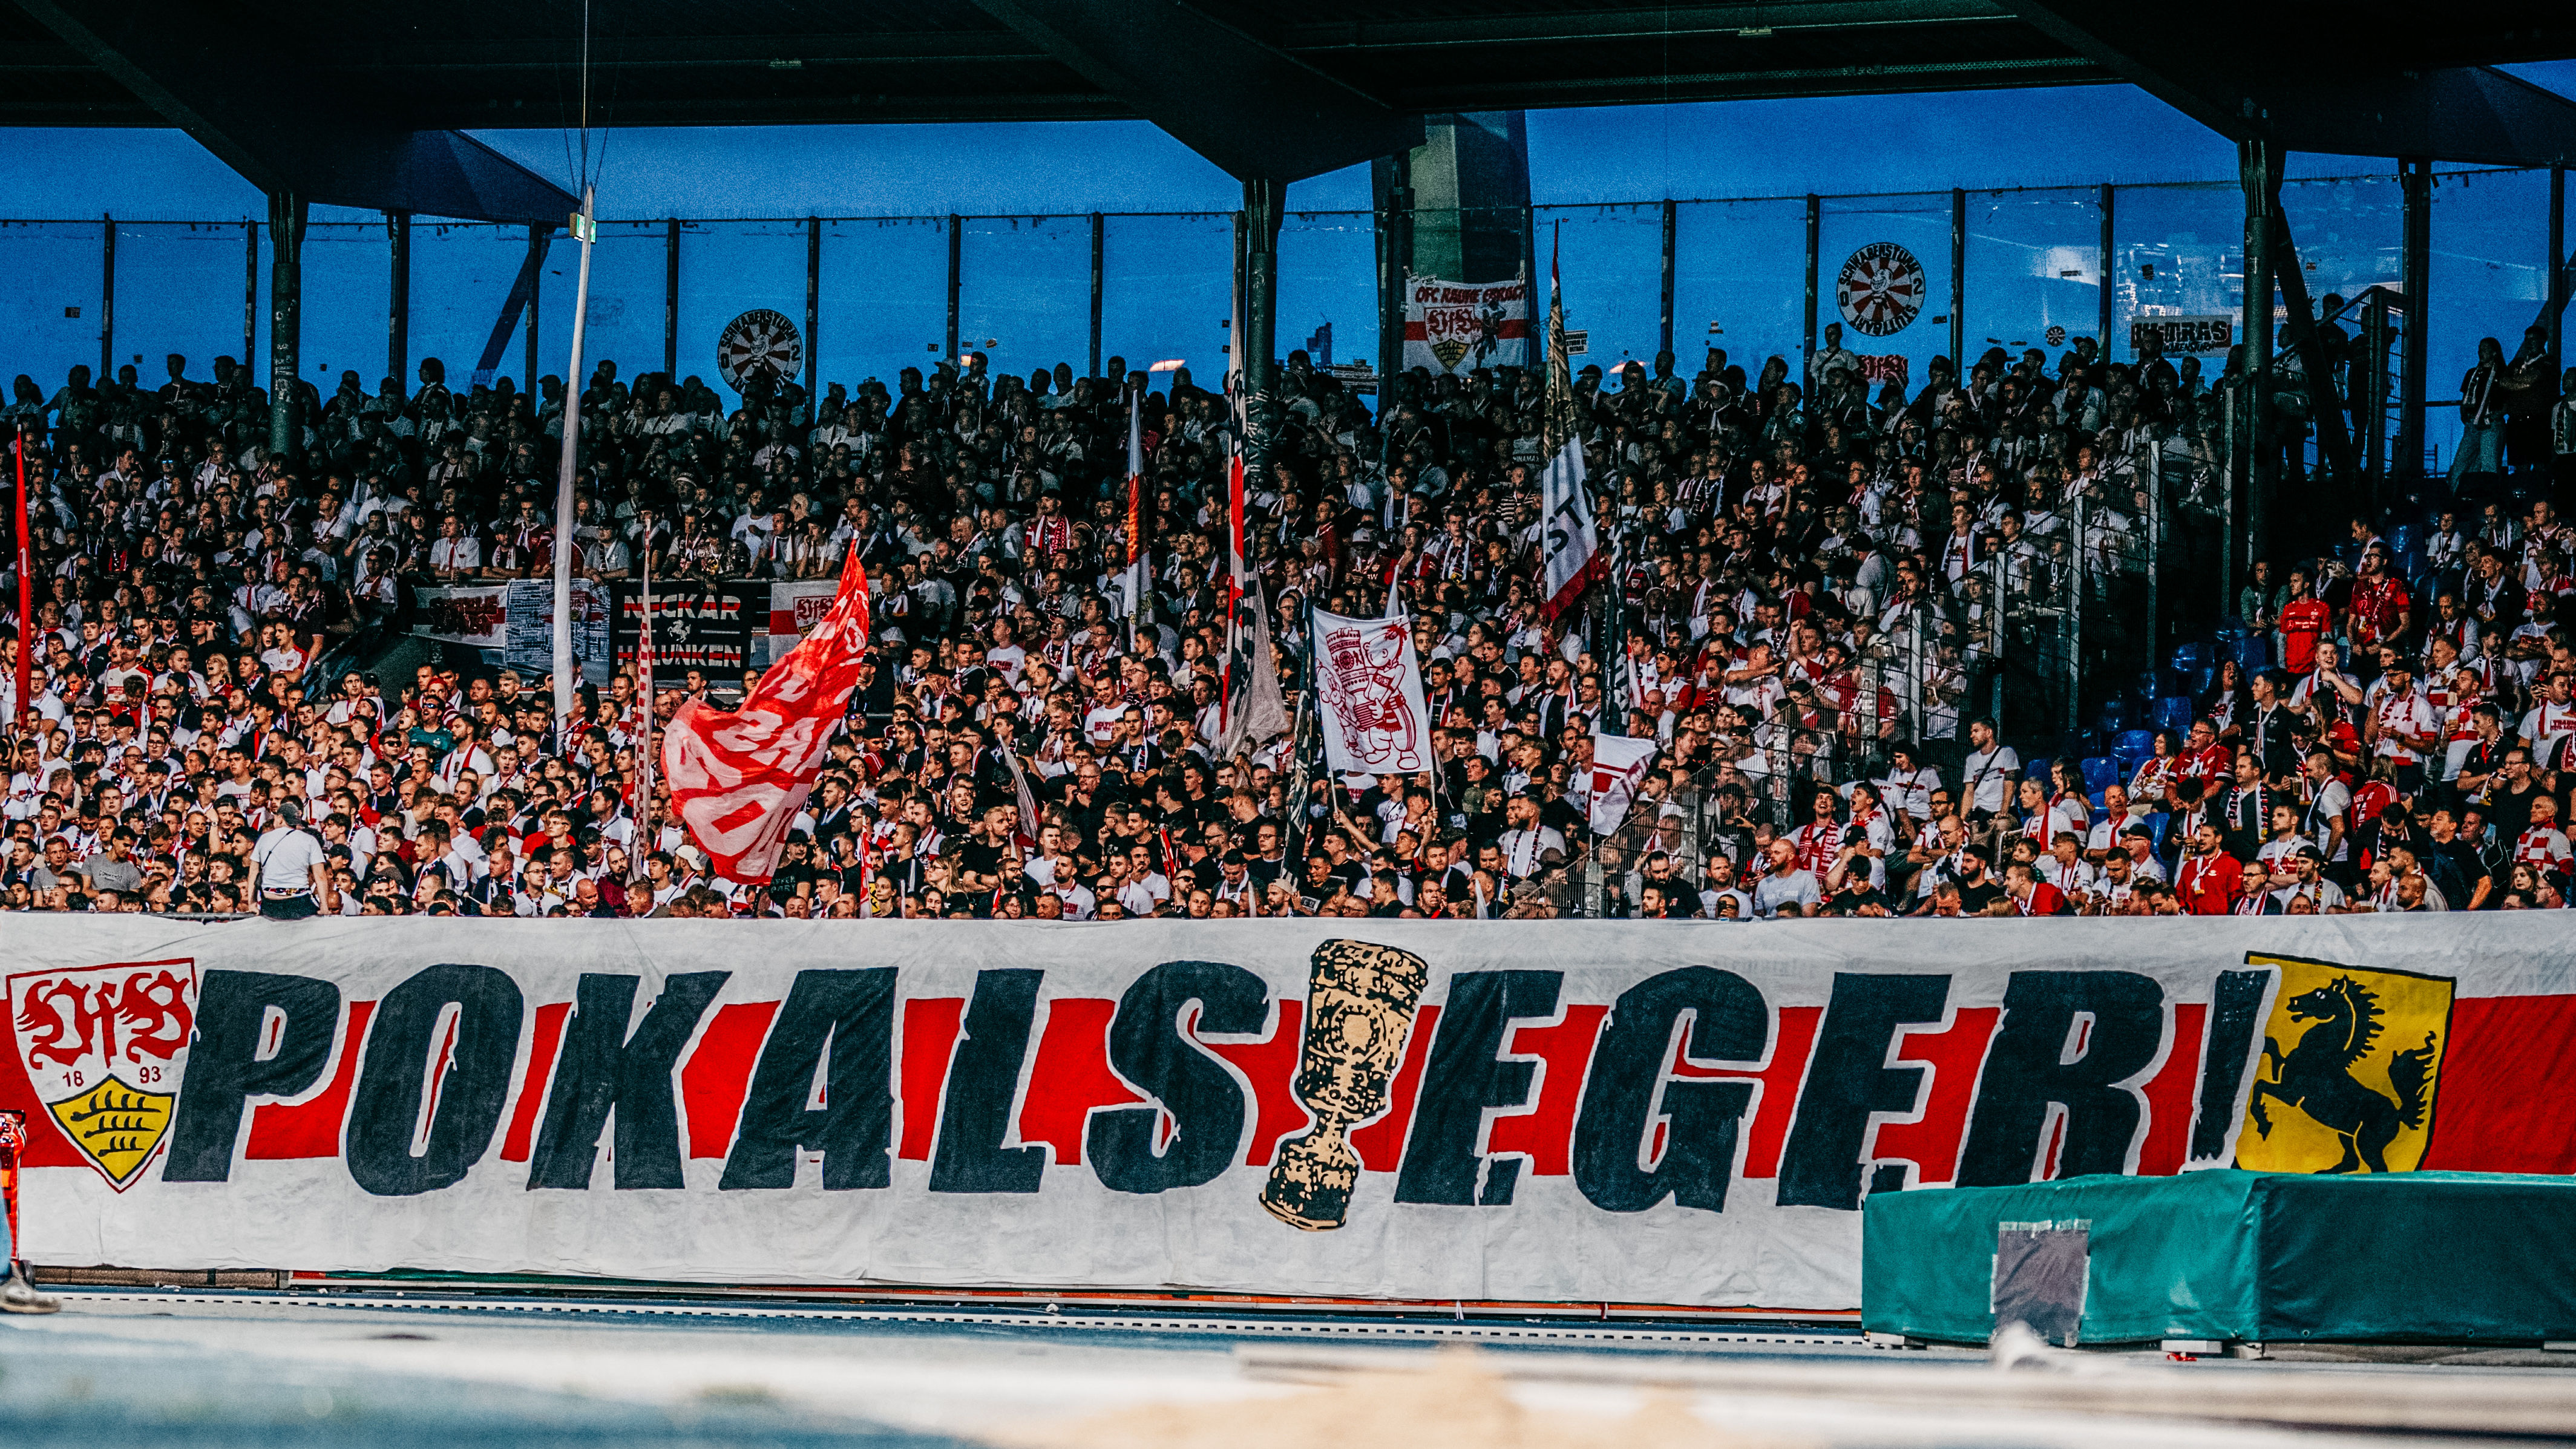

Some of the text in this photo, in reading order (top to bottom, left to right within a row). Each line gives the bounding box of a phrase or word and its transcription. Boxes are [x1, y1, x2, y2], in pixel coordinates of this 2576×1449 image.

[1839, 243, 1919, 286] SCHWABENSTURM
[1415, 286, 1440, 303] OFC
[720, 311, 798, 348] SCHWABENSTURM
[623, 594, 741, 620] NECKAR
[617, 644, 741, 668] HLUNKEN
[17, 970, 195, 1070] VfB
[62, 1065, 162, 1088] 18 93
